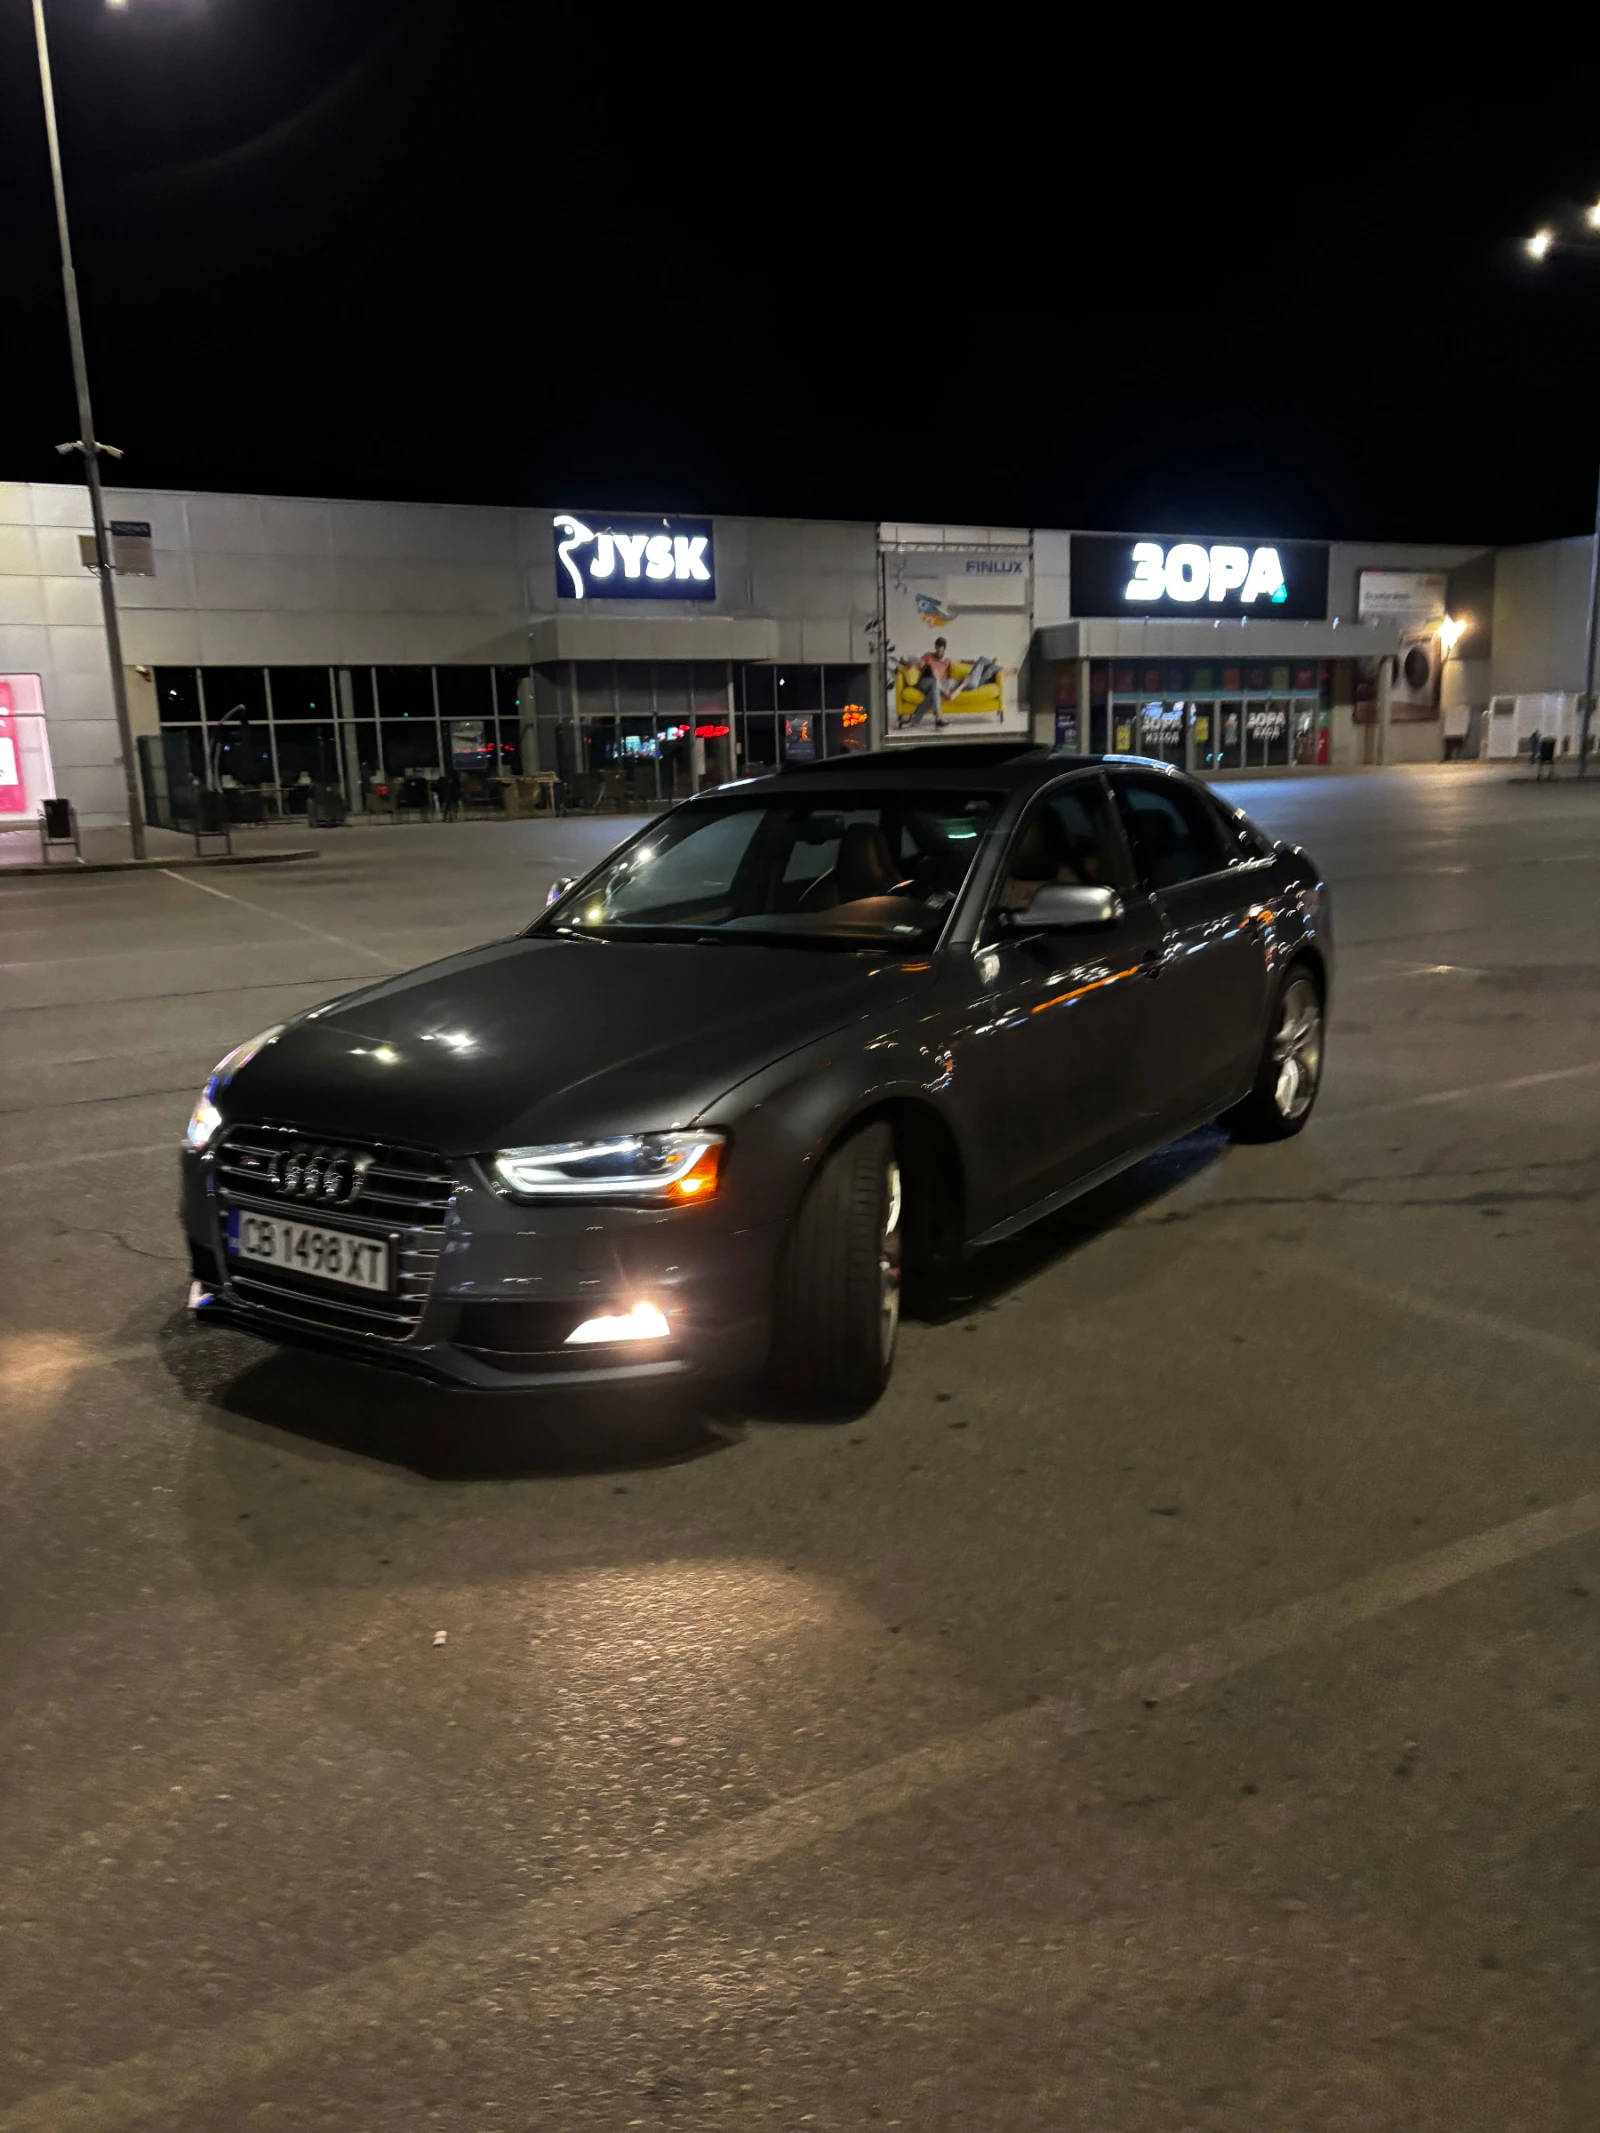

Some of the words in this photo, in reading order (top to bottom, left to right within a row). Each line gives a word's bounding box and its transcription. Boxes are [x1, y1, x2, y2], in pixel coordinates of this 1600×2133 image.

[589, 533, 711, 580] JYSK
[965, 559, 1023, 574] FINLUX
[1125, 542, 1288, 604] ЗОРА
